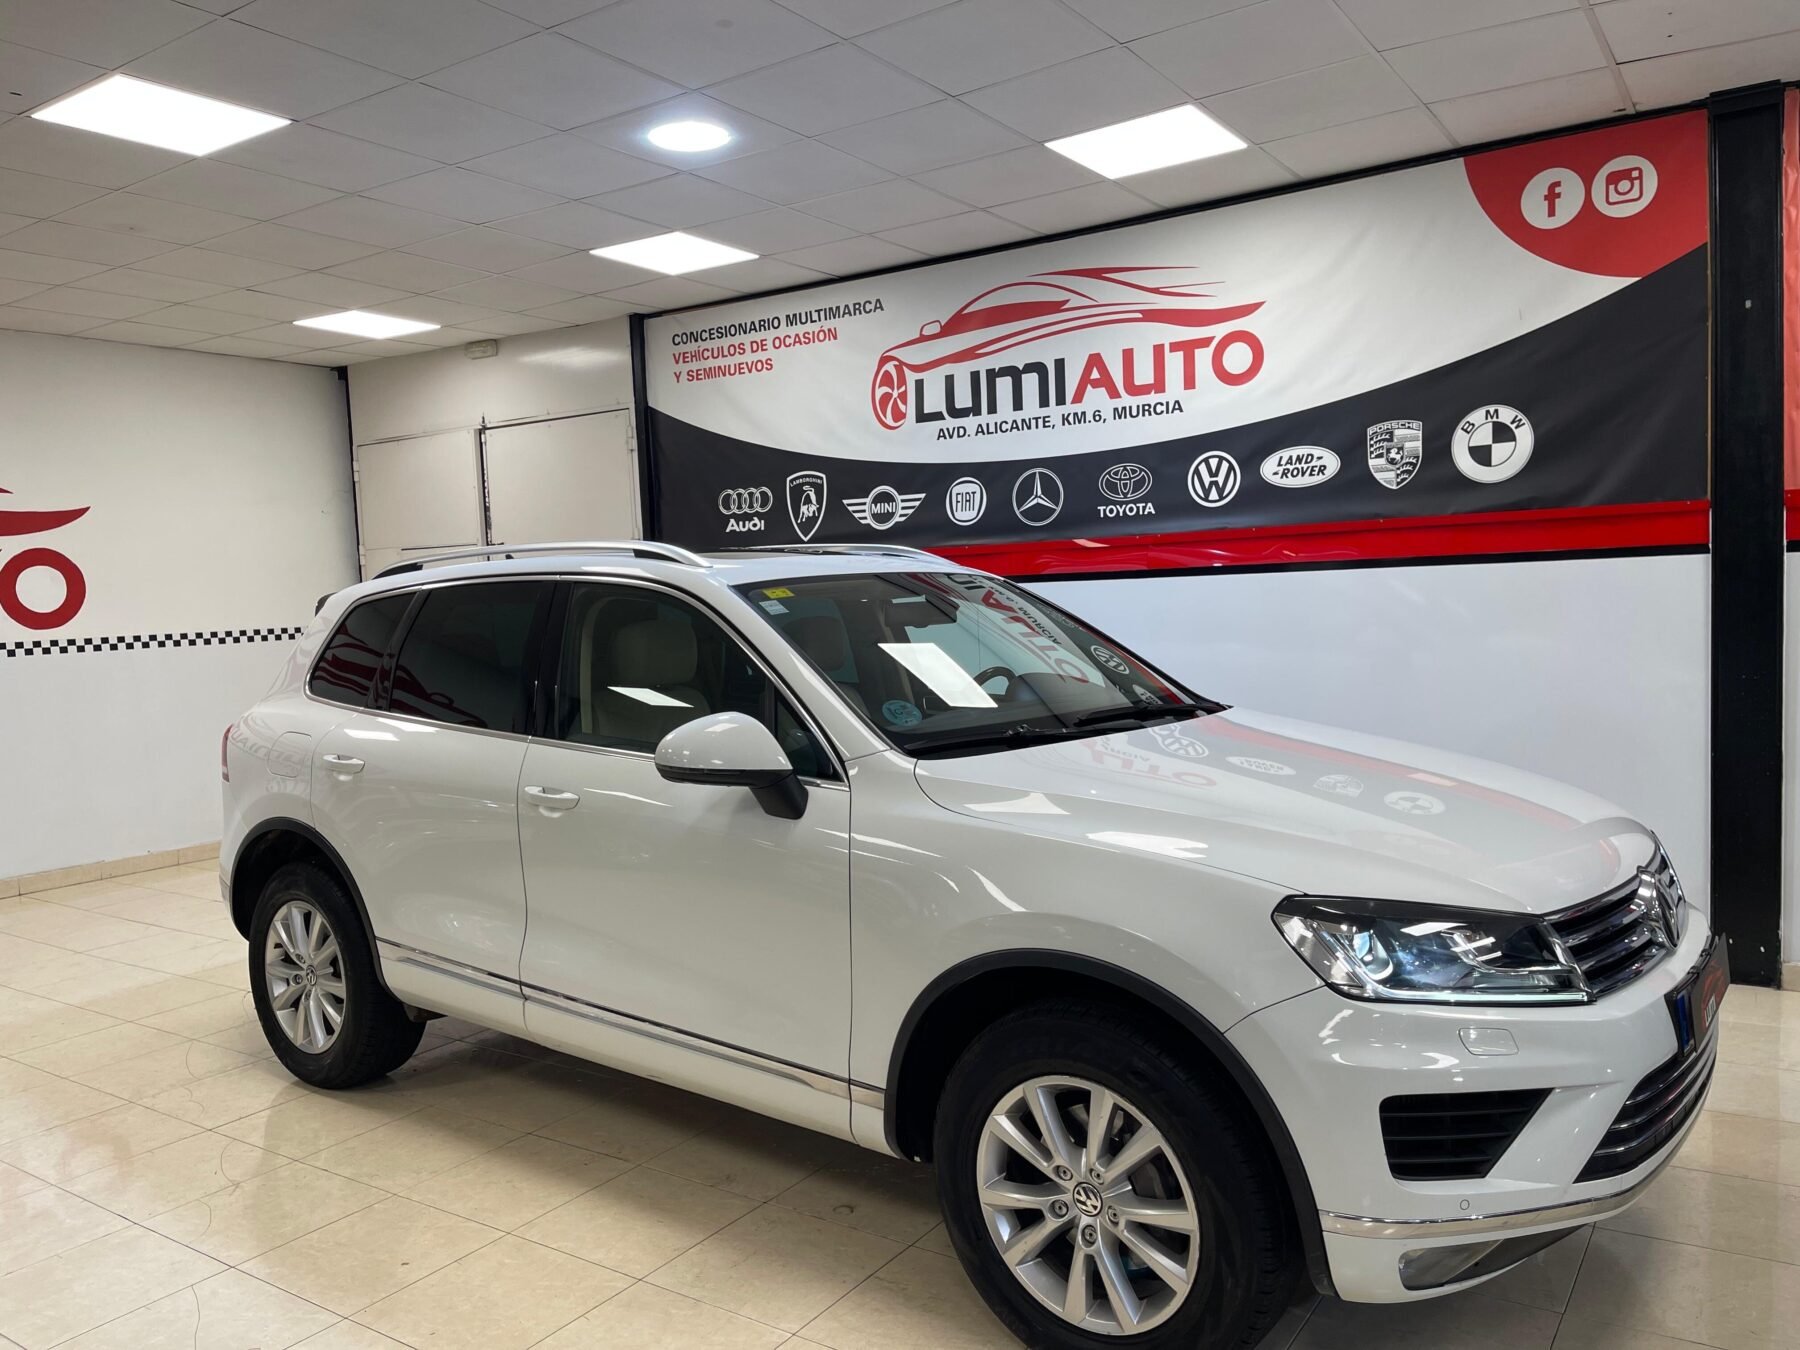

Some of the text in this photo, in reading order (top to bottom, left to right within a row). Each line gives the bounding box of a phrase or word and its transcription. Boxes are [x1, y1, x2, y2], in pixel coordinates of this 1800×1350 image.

[672, 298, 885, 346] CONCESIONARIO MULTIMARCA
[673, 326, 838, 365] VEHÍCULOS DE OCASIÓN
[673, 357, 774, 384] Y SEMINUEVOS
[936, 399, 1184, 441] AVD. ALICANTE, KM.6, MURCIA
[1370, 422, 1421, 435] PORSCHE
[1461, 408, 1526, 435] BMW
[871, 501, 896, 514] MINI
[955, 490, 977, 513] FIAT
[1097, 502, 1155, 518] TOYOTA
